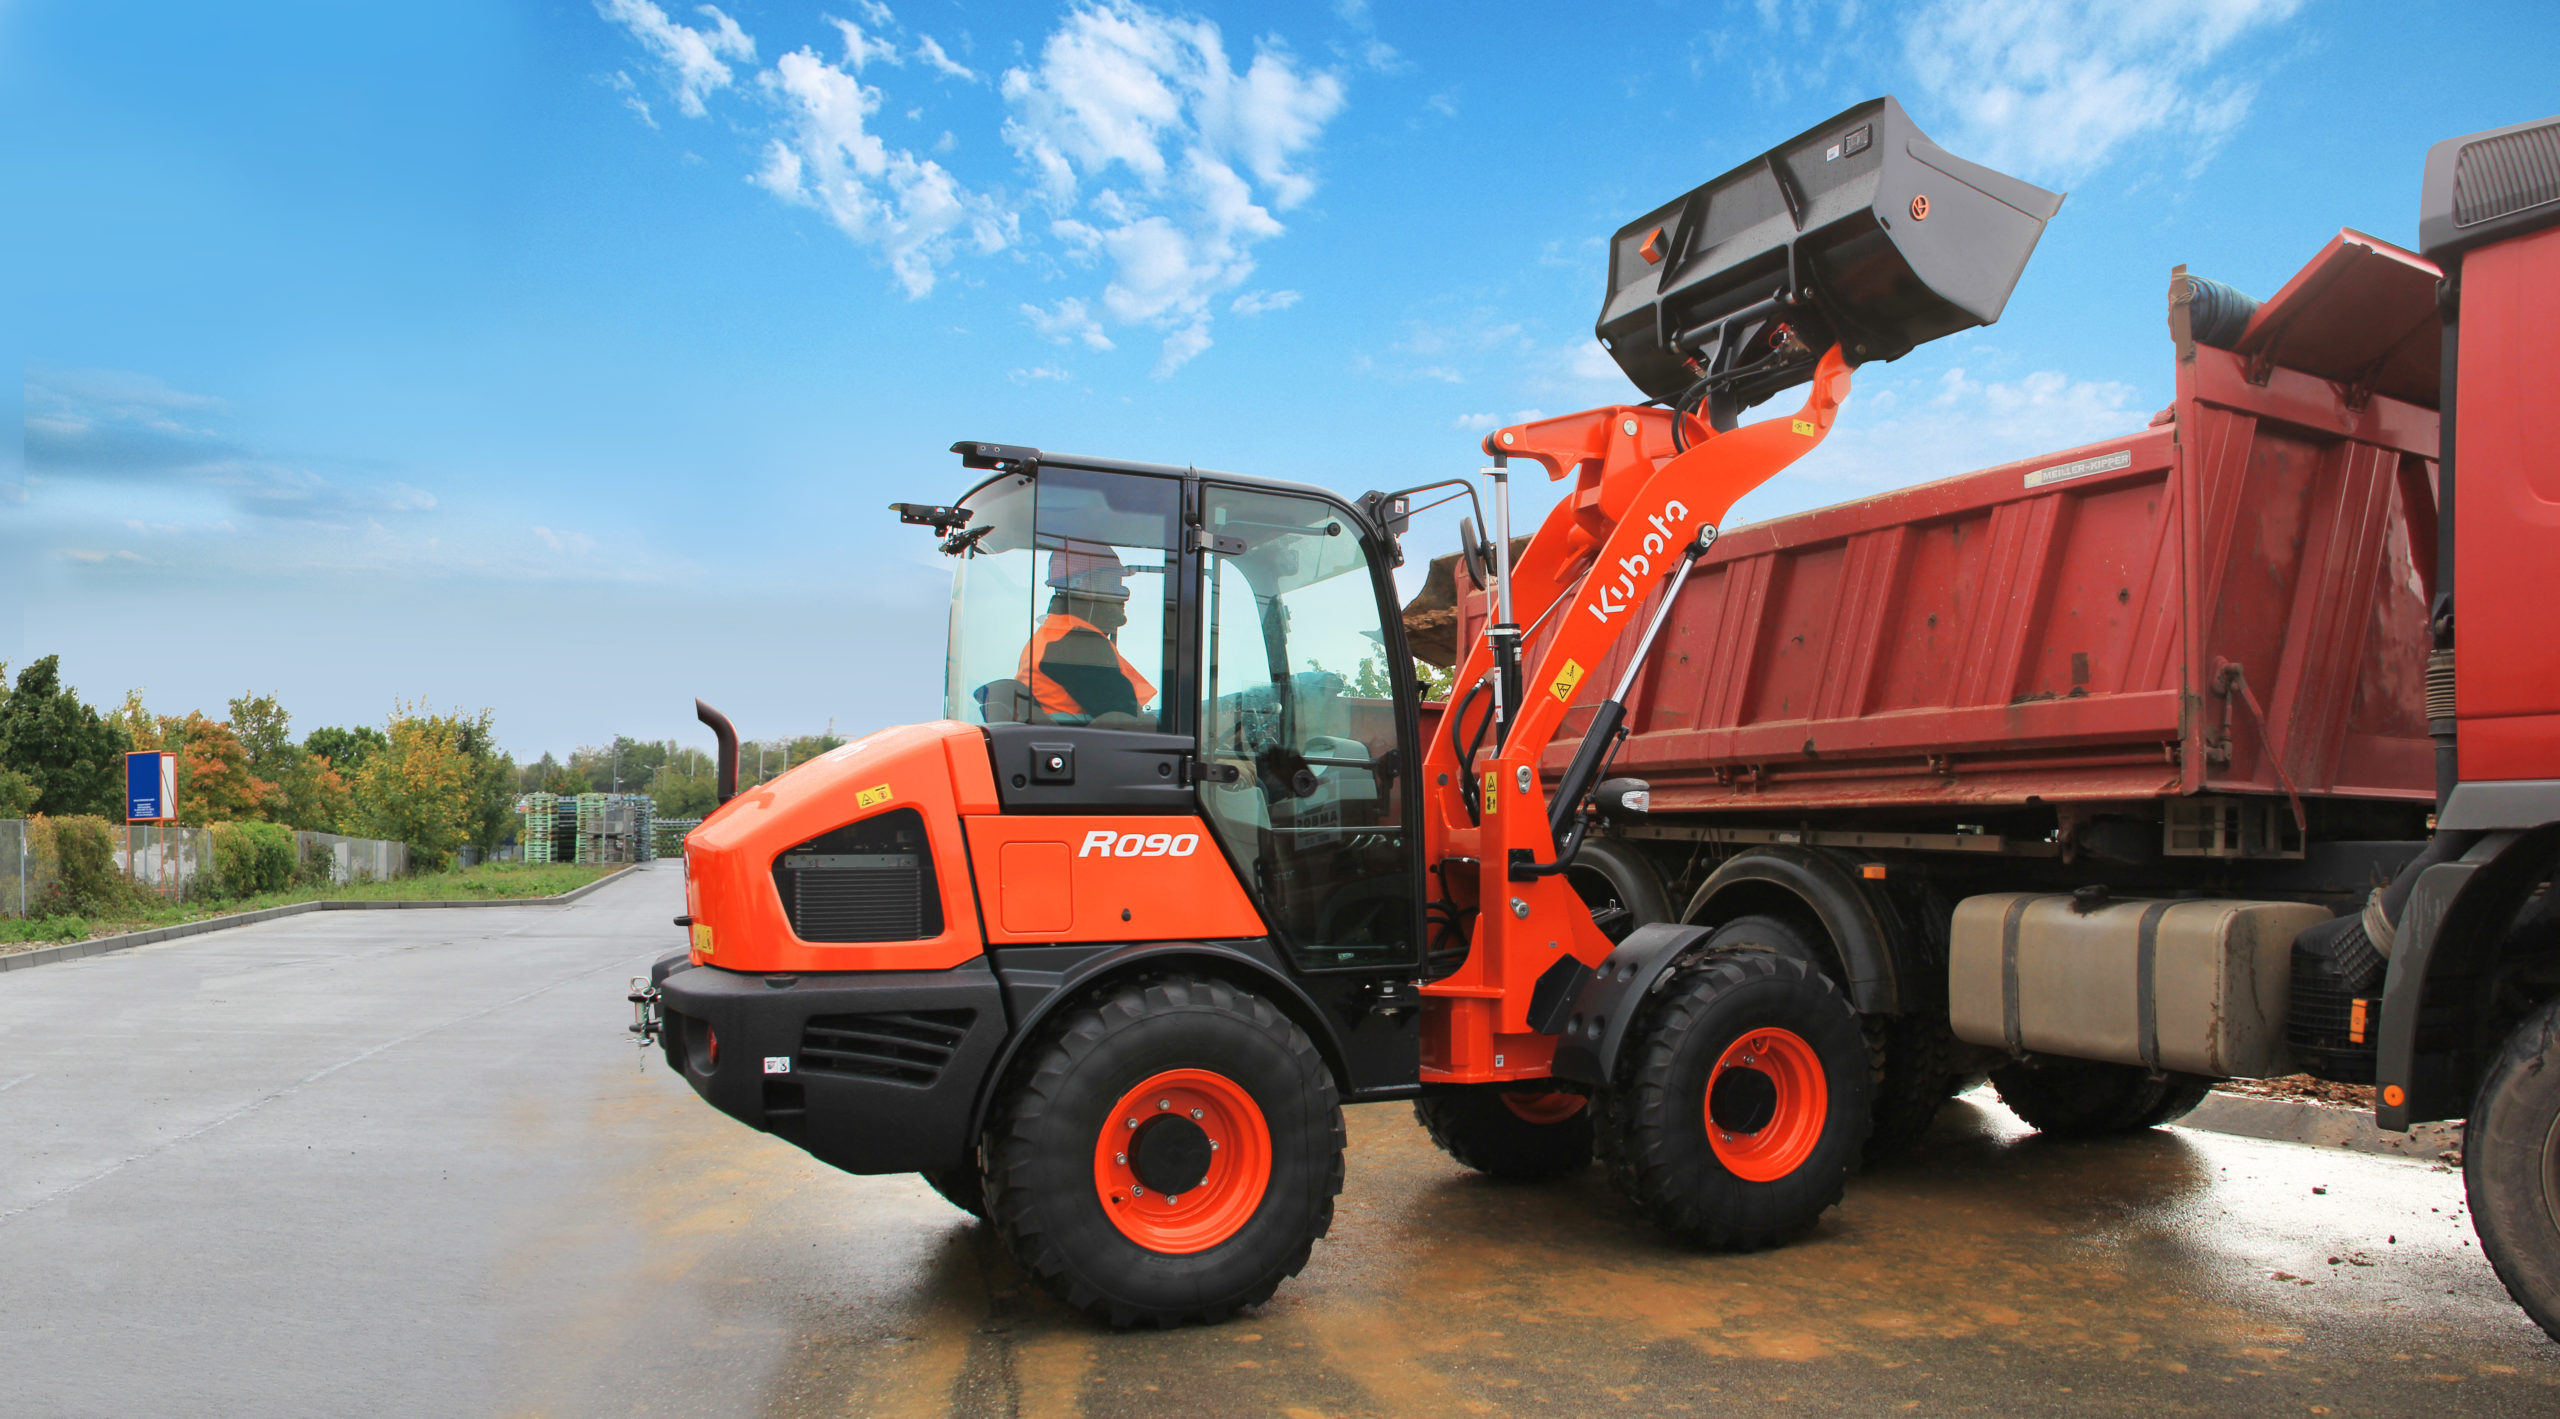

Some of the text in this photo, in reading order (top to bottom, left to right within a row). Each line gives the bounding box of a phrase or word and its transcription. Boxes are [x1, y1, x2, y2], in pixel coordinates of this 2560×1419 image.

[2042, 455, 2129, 480] MEILLER-KIPPER
[1588, 500, 1689, 623] Kubota
[1078, 830, 1199, 857] R090
